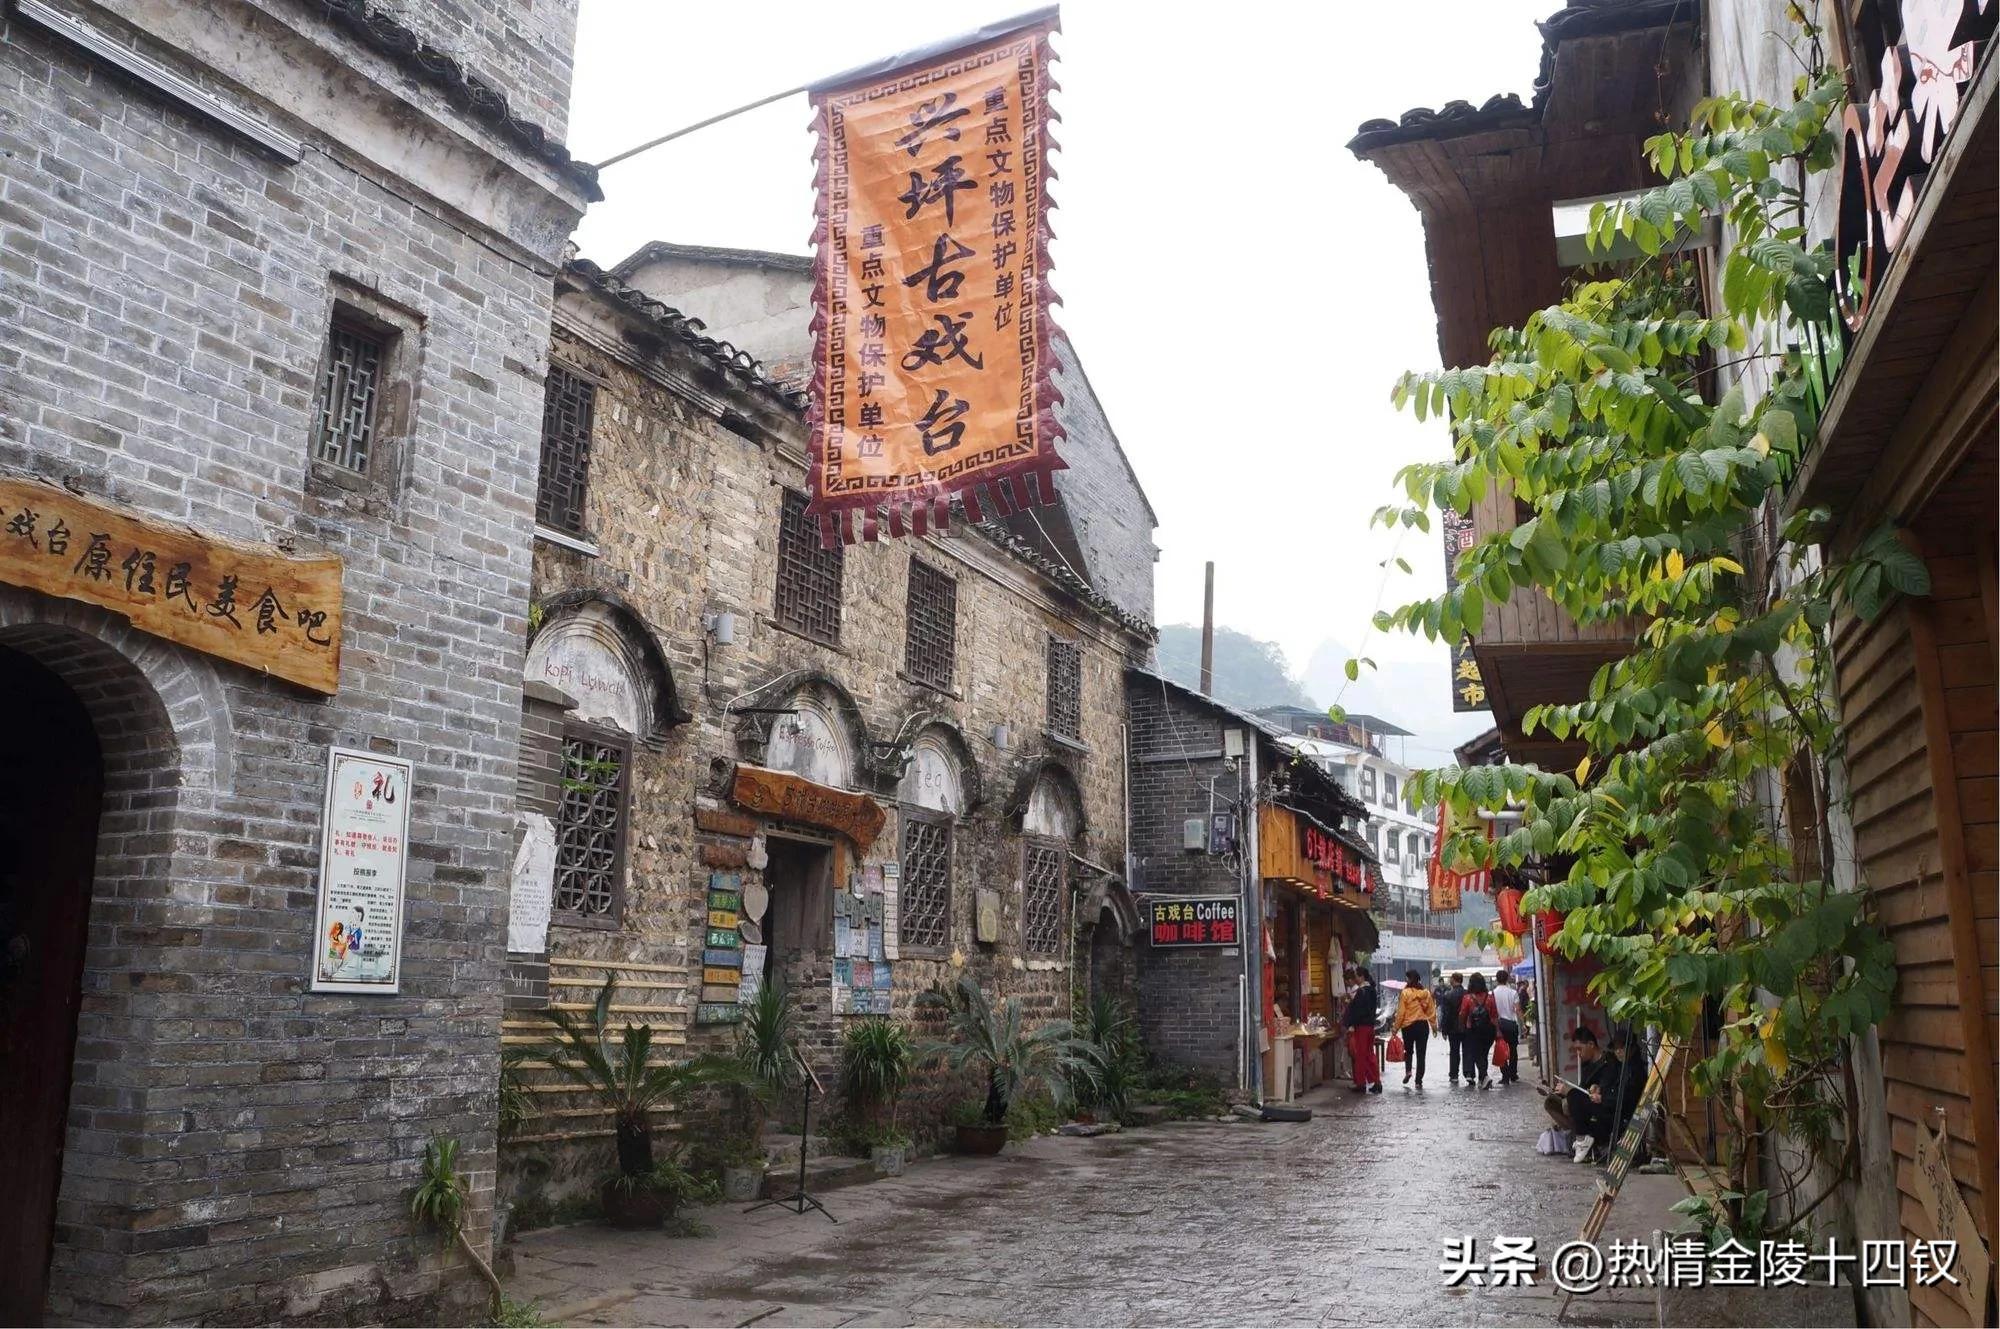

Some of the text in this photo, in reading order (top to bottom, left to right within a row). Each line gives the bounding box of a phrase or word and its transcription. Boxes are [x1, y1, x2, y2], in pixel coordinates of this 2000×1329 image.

[981, 86, 1017, 332] 重点文物保护单位
[895, 90, 985, 458] 兴坪古戏台
[856, 224, 887, 460] 重点文物保护单位
[0, 506, 331, 647] 戏台原住民美食吧
[371, 771, 396, 805] 礼
[915, 769, 942, 789] tea
[1197, 902, 1235, 919] Coffee
[711, 932, 735, 945] 西瓜汁
[1154, 920, 1234, 942] 咖啡馆
